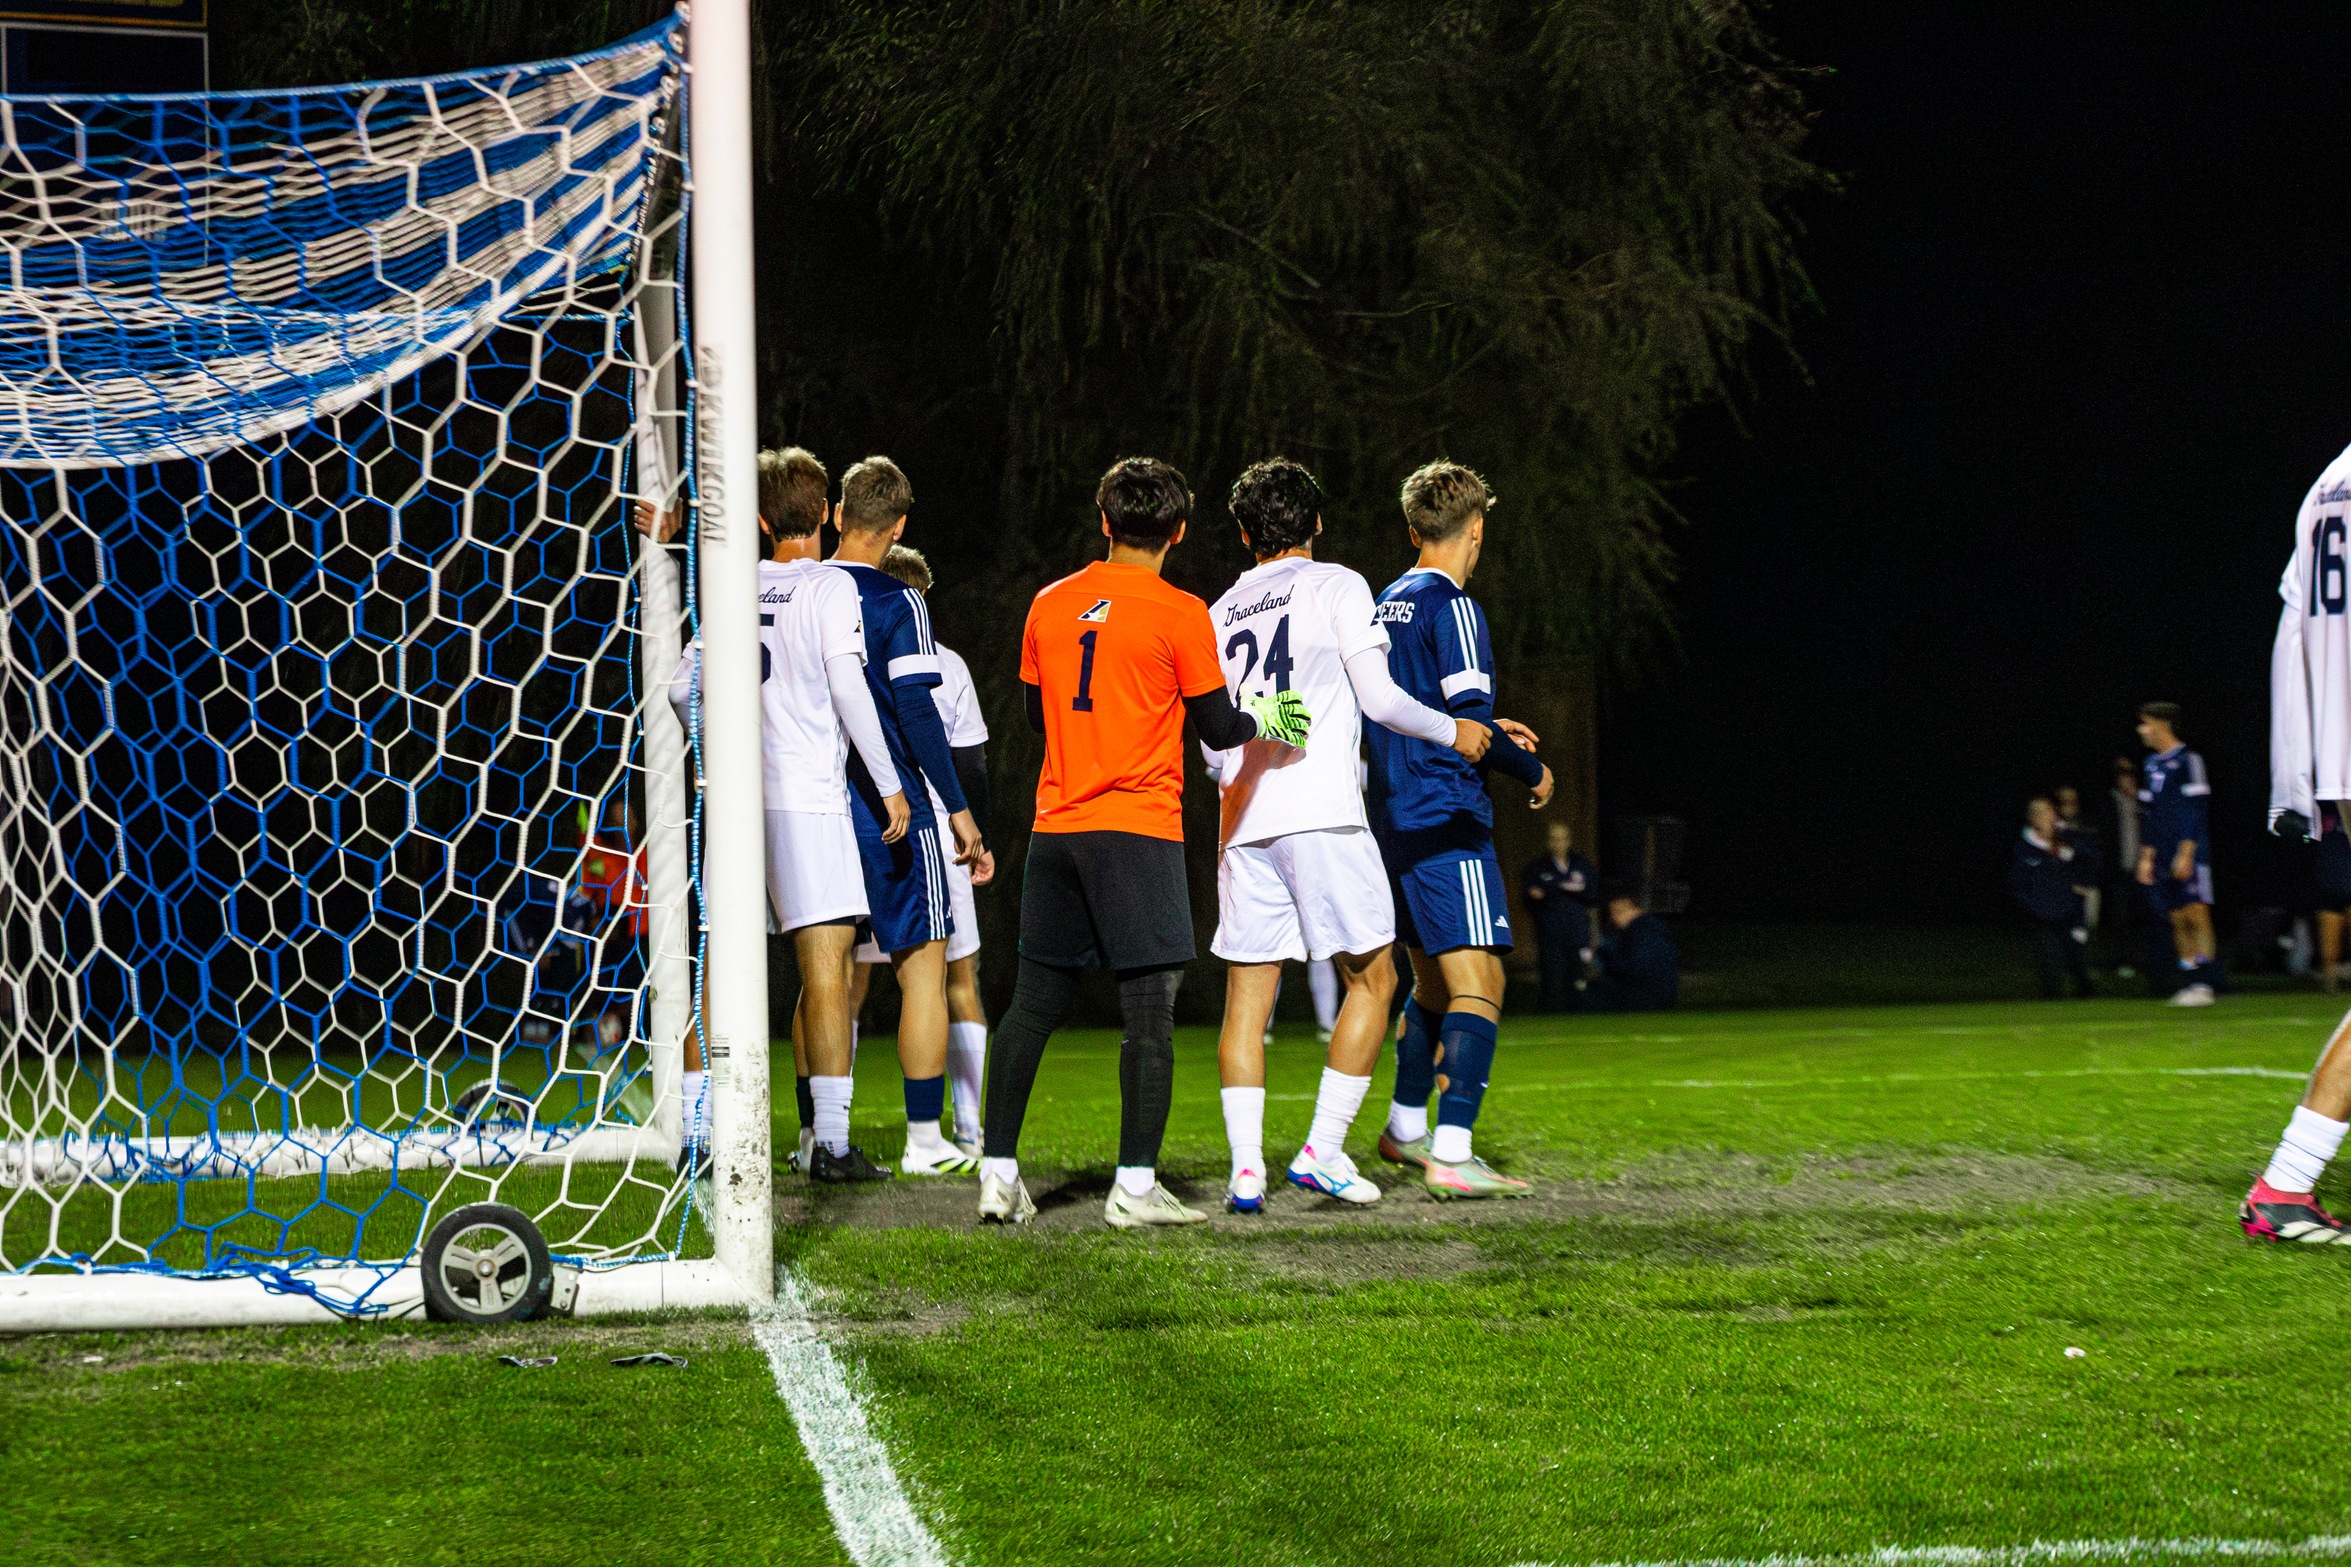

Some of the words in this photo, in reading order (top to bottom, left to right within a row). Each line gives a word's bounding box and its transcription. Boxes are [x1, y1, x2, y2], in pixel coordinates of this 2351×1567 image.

[1223, 584, 1295, 627] Graceland
[2310, 516, 2347, 617] 16
[1072, 629, 1098, 712] 1
[1225, 613, 1294, 712] 24
